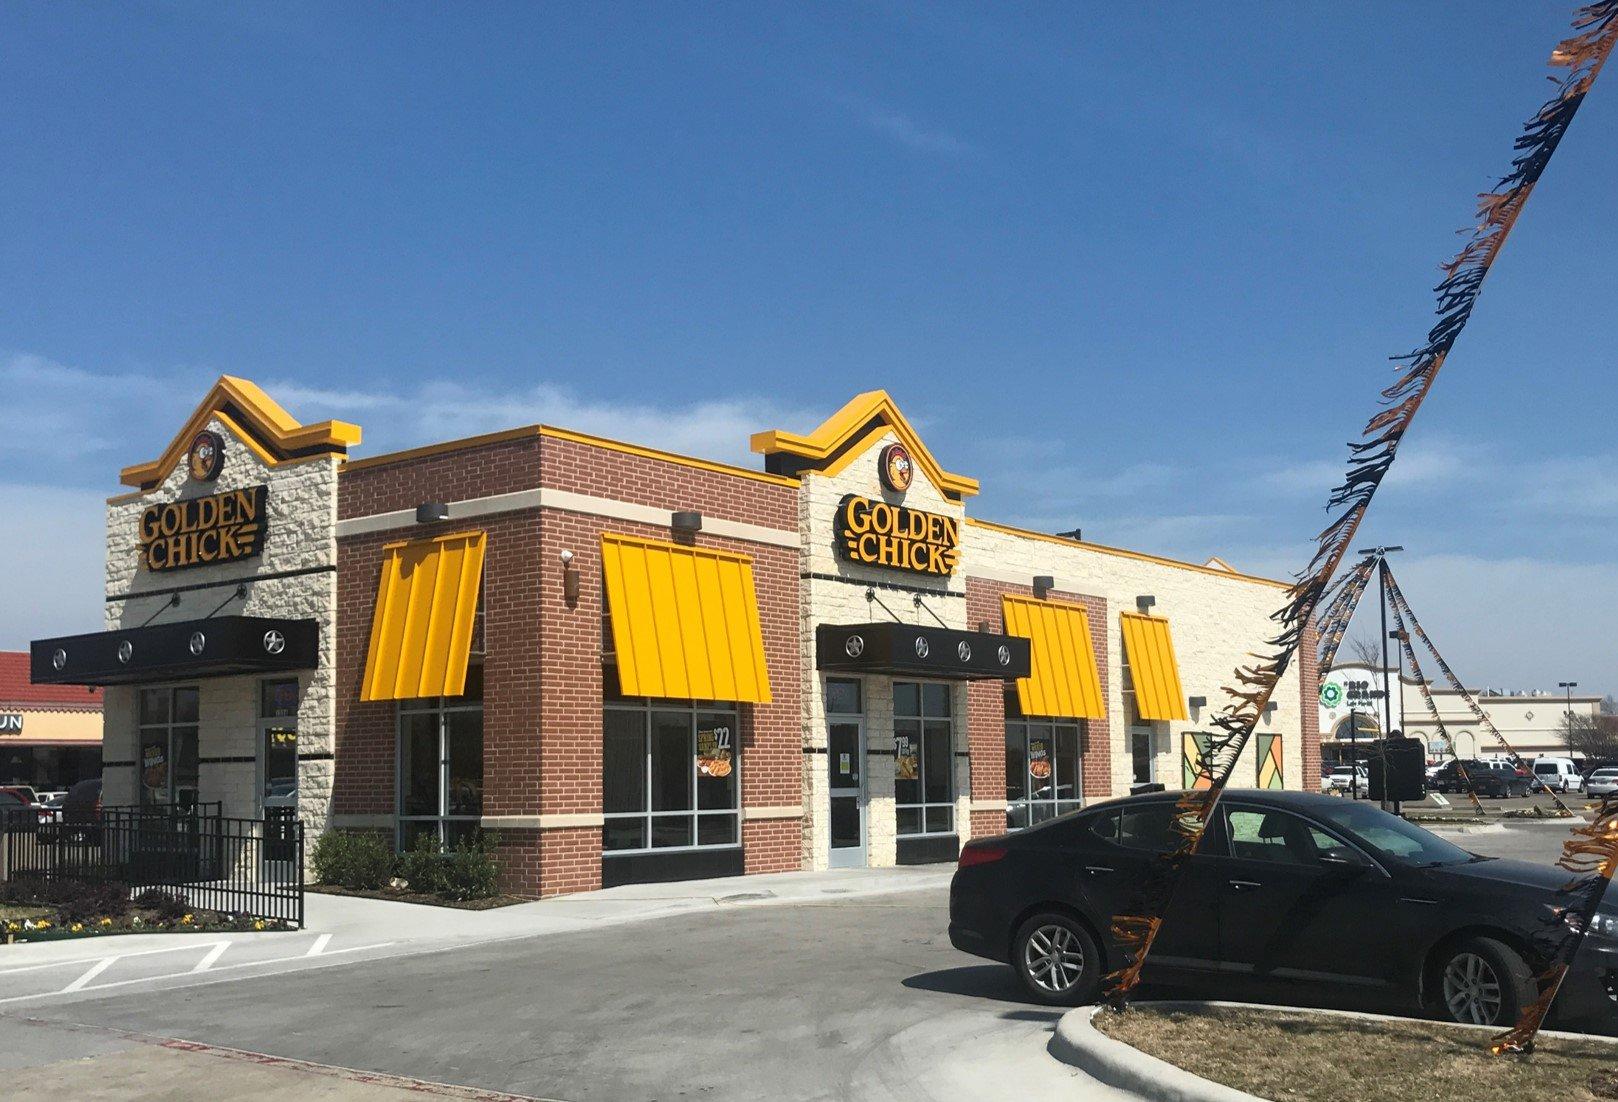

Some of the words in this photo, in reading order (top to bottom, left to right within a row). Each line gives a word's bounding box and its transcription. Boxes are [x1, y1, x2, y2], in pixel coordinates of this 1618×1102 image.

[140, 488, 258, 544] GOLDEN
[847, 496, 960, 547] GOLDEN
[149, 525, 242, 569] CHICK
[859, 533, 949, 575] CHICK
[1346, 689, 1391, 700] GRAND
